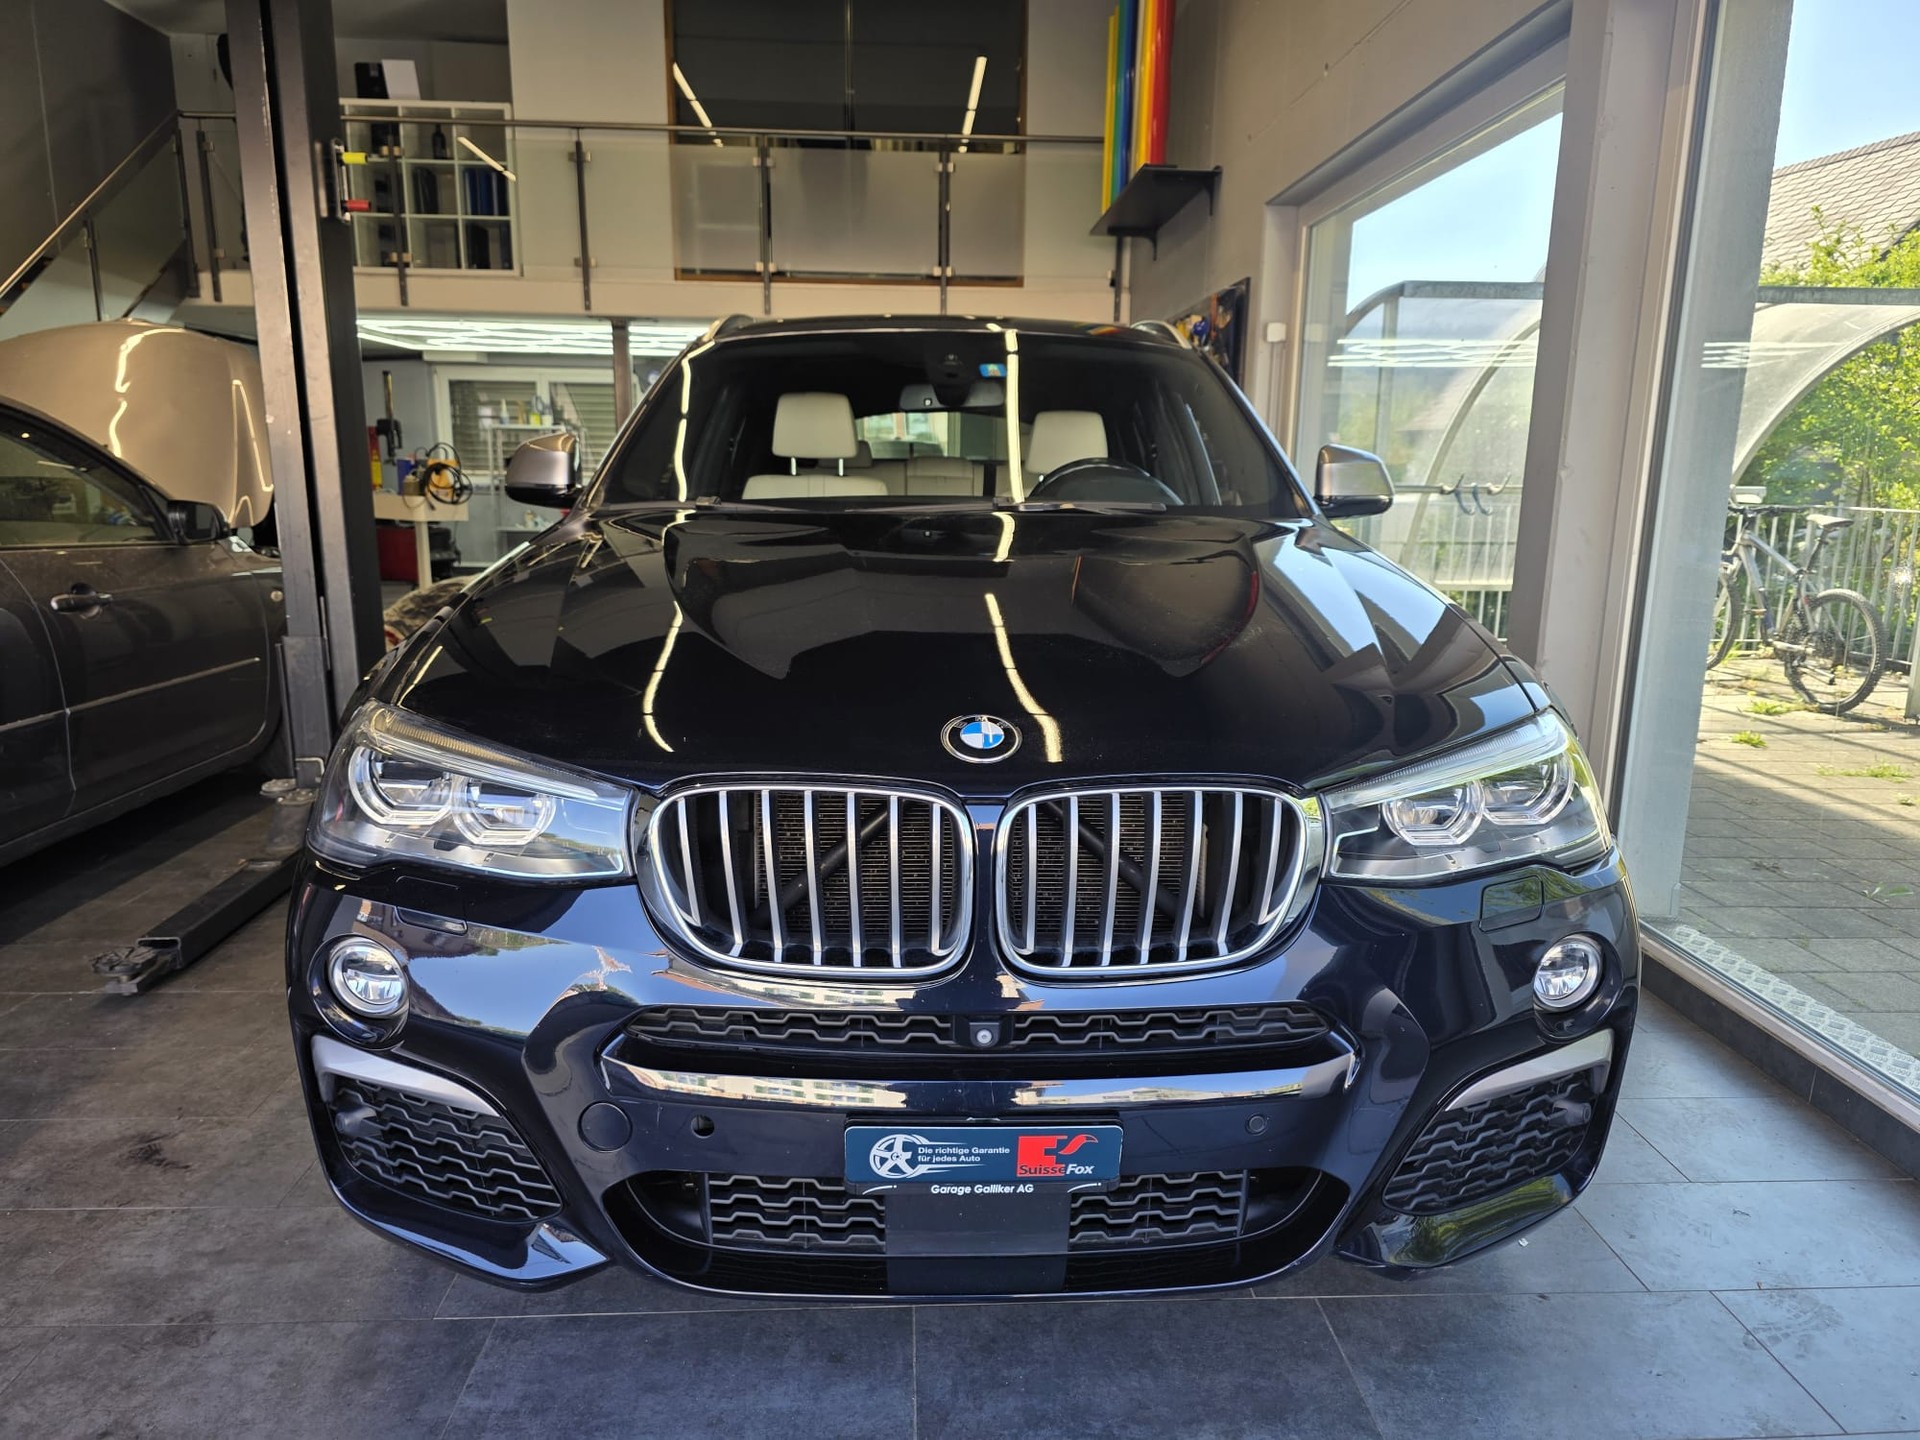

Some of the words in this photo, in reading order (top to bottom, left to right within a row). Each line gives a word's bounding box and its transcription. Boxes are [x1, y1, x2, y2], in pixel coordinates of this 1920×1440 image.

[935, 1147, 970, 1155] richtige
[931, 1155, 957, 1163] jedes
[930, 1184, 972, 1196] Garage
[973, 1184, 1015, 1194] Galliker
[1016, 1184, 1035, 1194] AG
